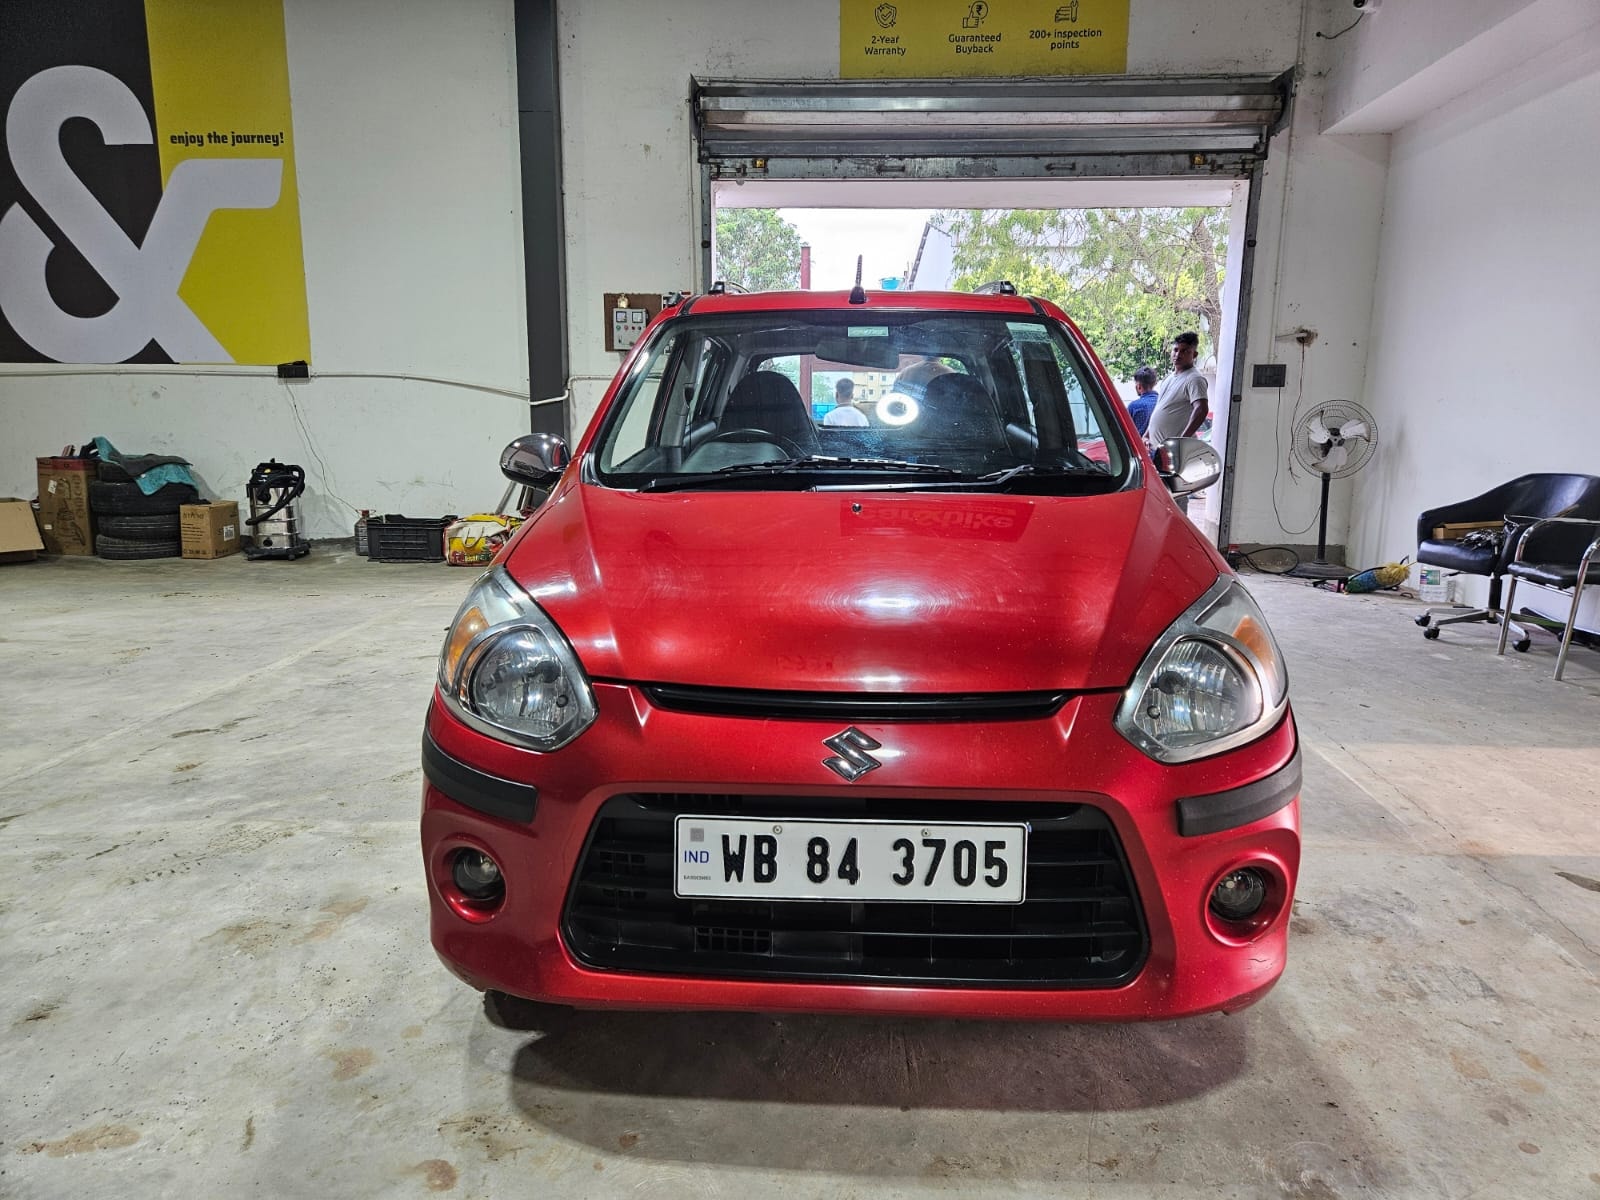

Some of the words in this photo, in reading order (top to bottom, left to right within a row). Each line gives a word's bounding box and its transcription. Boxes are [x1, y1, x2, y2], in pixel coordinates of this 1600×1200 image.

[948, 32, 1002, 43] Guaranteed
[1029, 30, 1051, 39] 200+
[1053, 28, 1102, 39] inspection
[871, 35, 900, 44] 2-Year
[864, 46, 907, 56] Warranty
[955, 43, 994, 54] Buyback
[1050, 40, 1080, 51] points
[170, 131, 205, 147] enjoy
[207, 131, 229, 144] the
[231, 131, 285, 147] journey!
[683, 850, 710, 864] IND
[721, 834, 778, 884] WB
[806, 836, 860, 886] 84
[892, 837, 1008, 888] 3705
